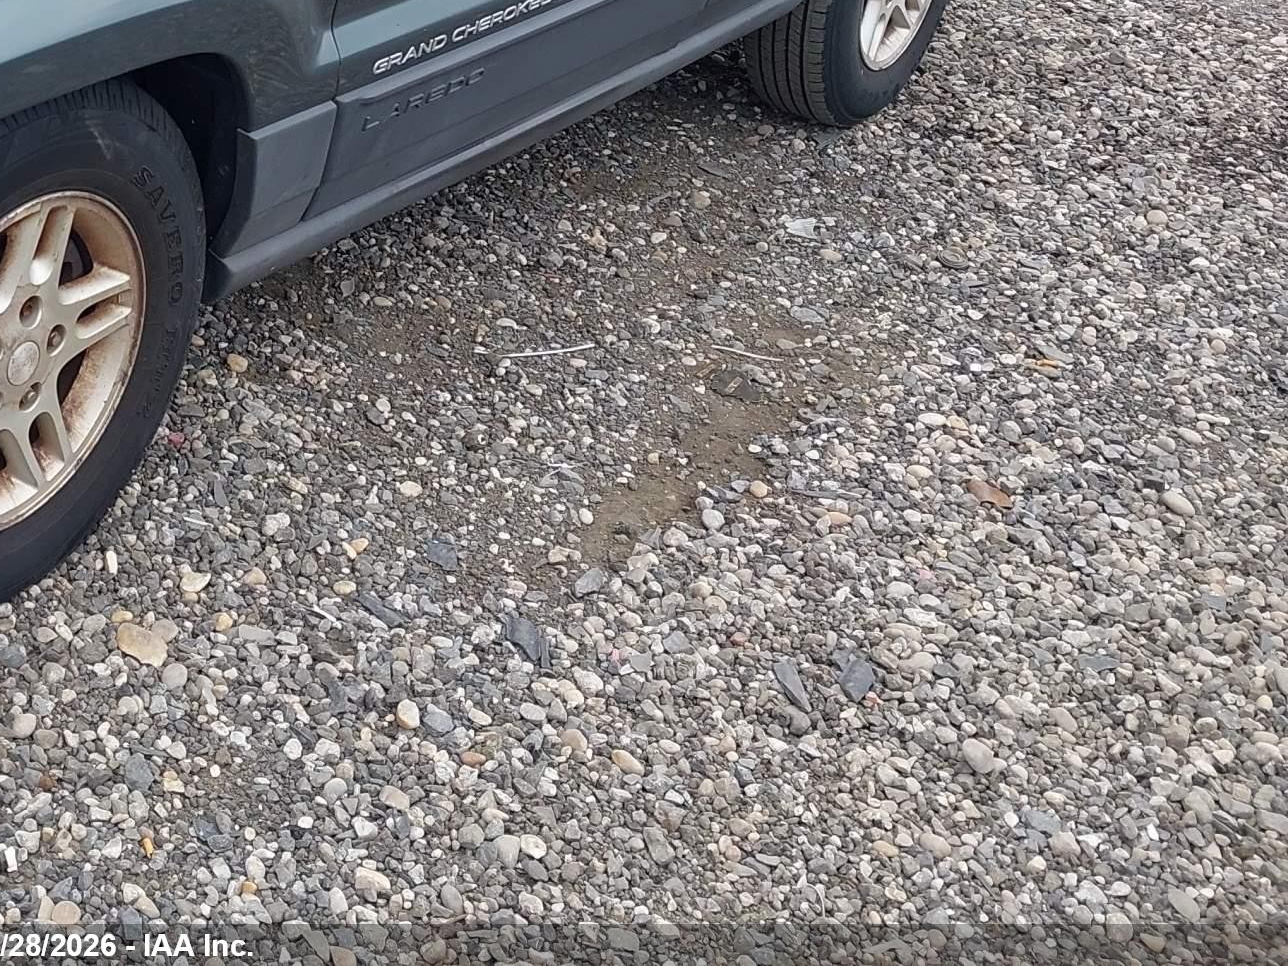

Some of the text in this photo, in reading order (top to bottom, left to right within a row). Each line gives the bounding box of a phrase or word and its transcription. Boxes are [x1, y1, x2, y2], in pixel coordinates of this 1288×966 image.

[372, 33, 448, 76] GRAND
[361, 66, 485, 132] LAREDO
[132, 165, 184, 305] SAVERO
